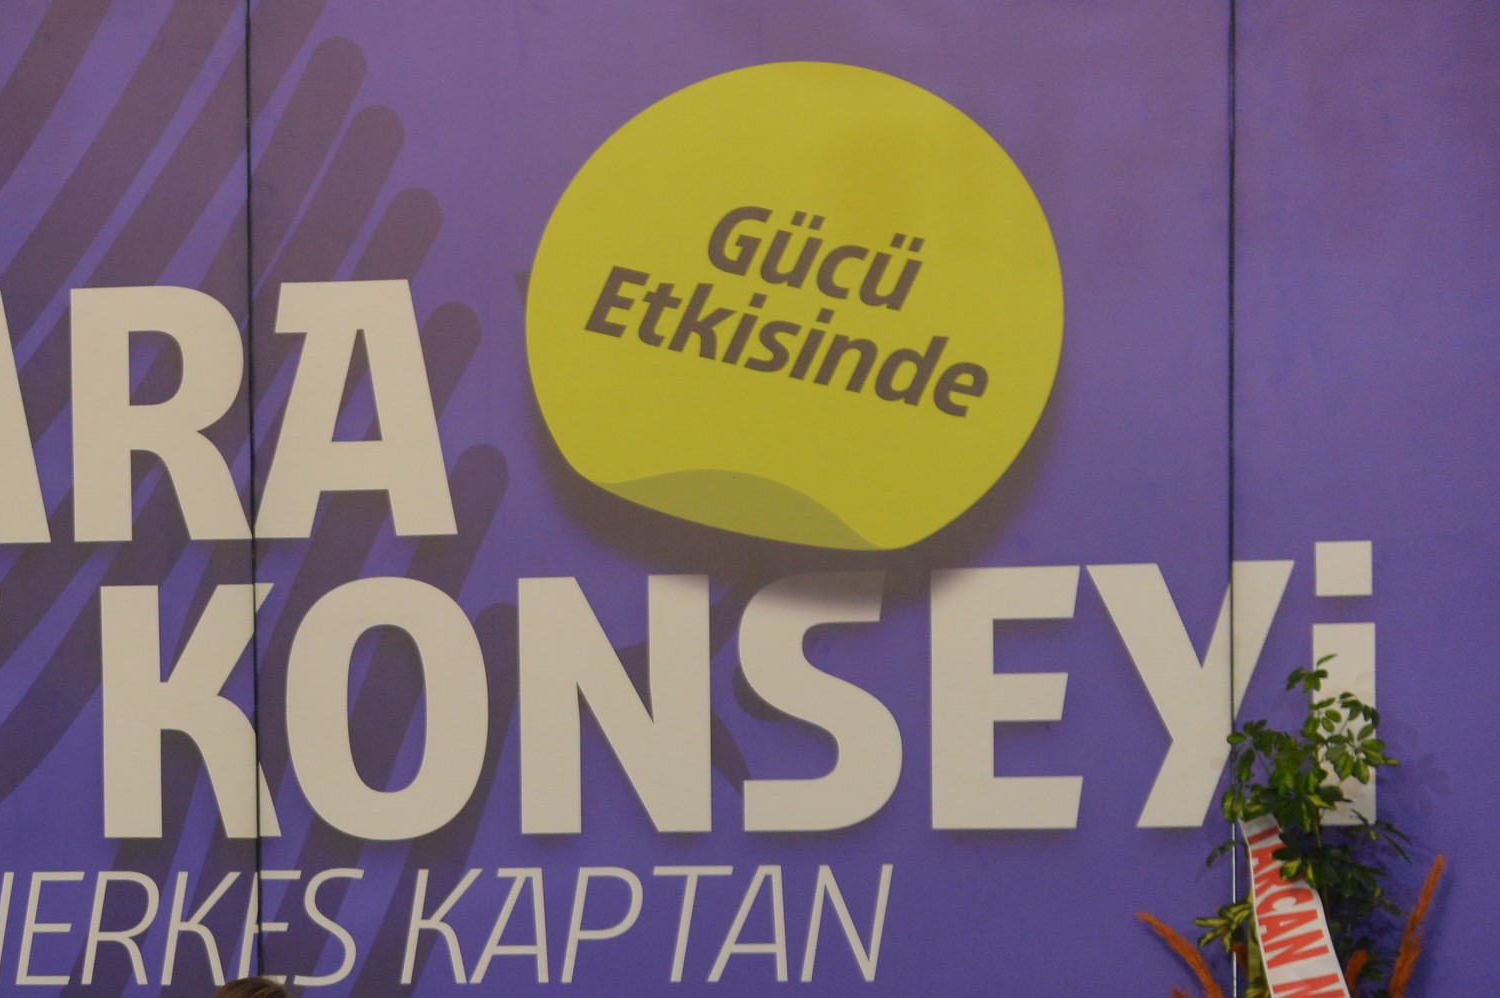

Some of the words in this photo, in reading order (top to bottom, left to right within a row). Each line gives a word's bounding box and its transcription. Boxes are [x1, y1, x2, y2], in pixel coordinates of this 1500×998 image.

[707, 205, 926, 312] Gücü
[583, 265, 990, 418] Etkisinde
[100, 540, 1376, 842] KONSEYİ
[400, 864, 893, 985] KAPTAN
